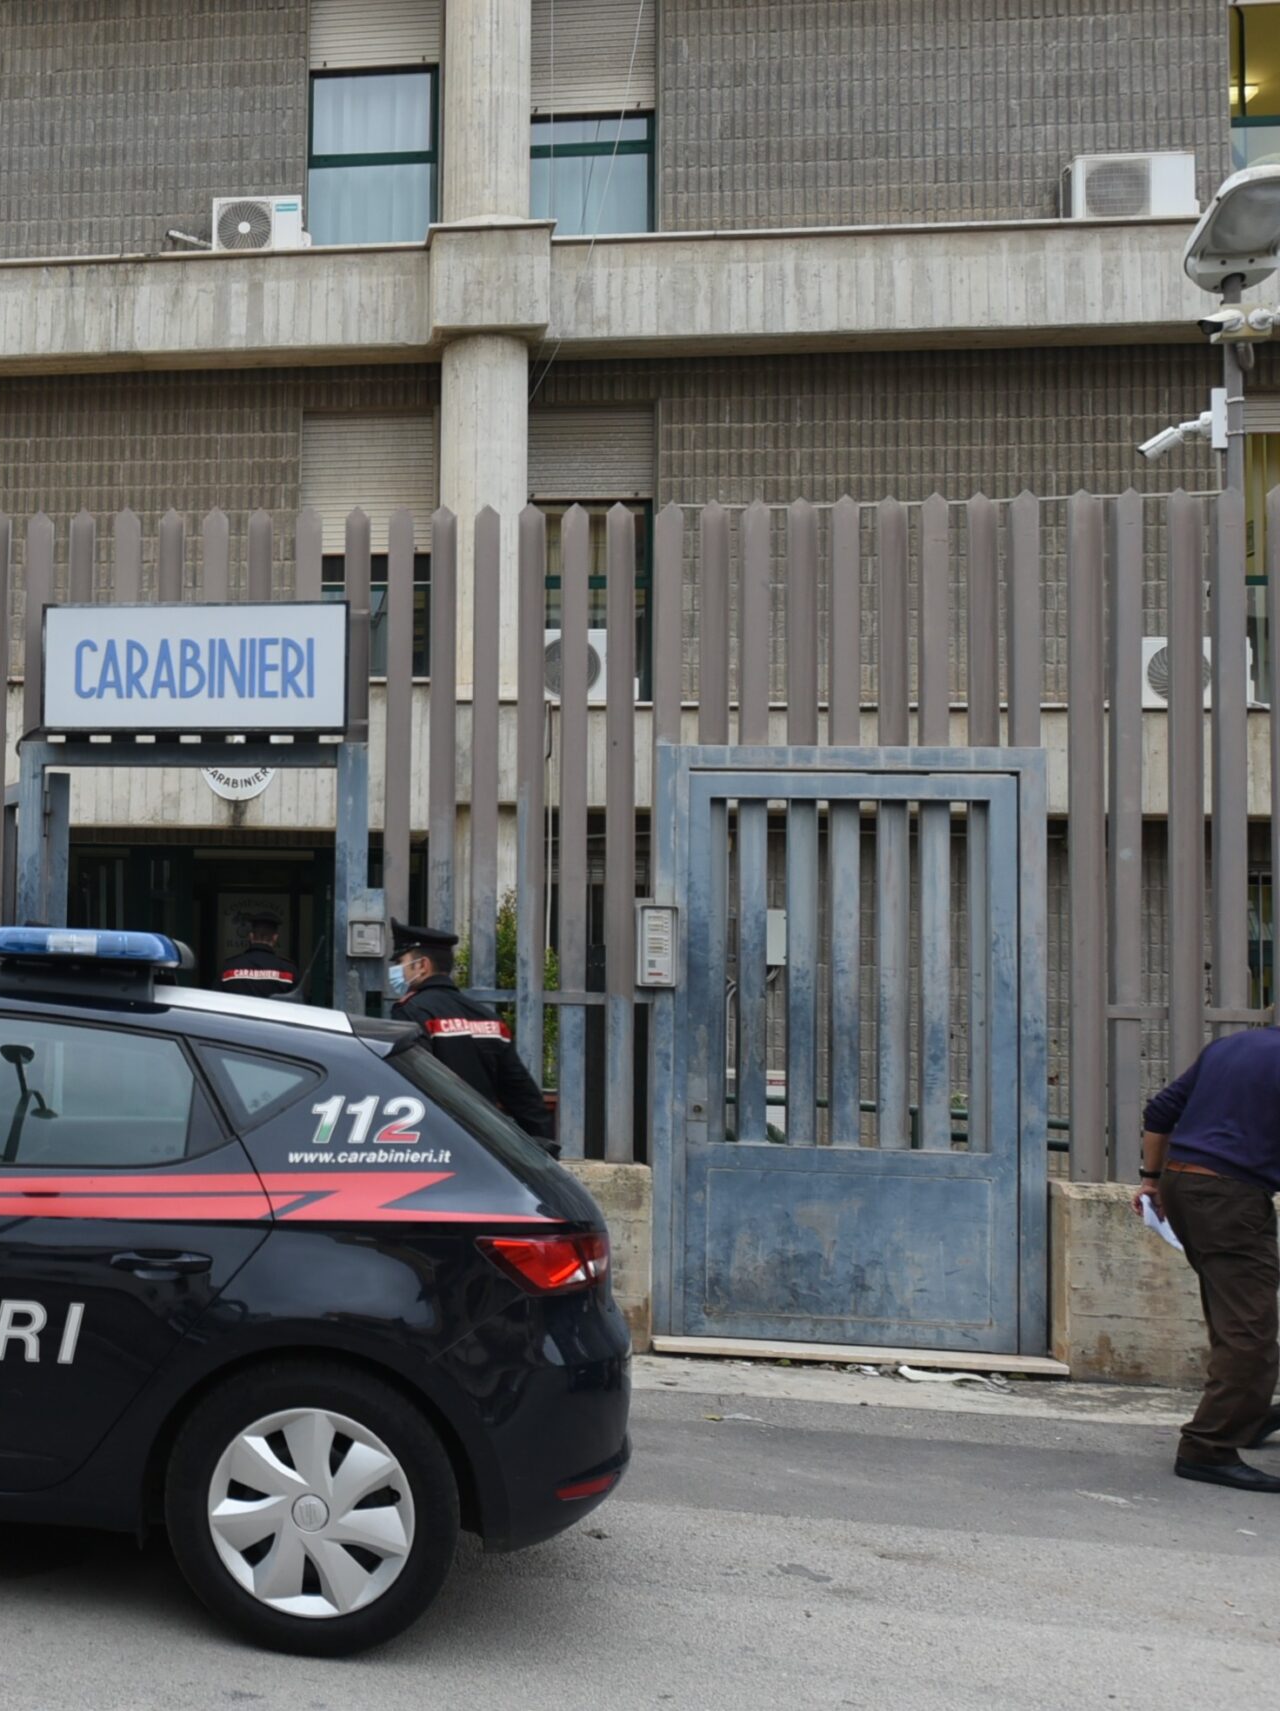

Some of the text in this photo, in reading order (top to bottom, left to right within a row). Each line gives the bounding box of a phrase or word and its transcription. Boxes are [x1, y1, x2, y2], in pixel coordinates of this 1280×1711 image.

[74, 637, 315, 699] CARABINIERI
[312, 1095, 426, 1144] 112
[288, 1149, 452, 1164] www.carabinieri.it
